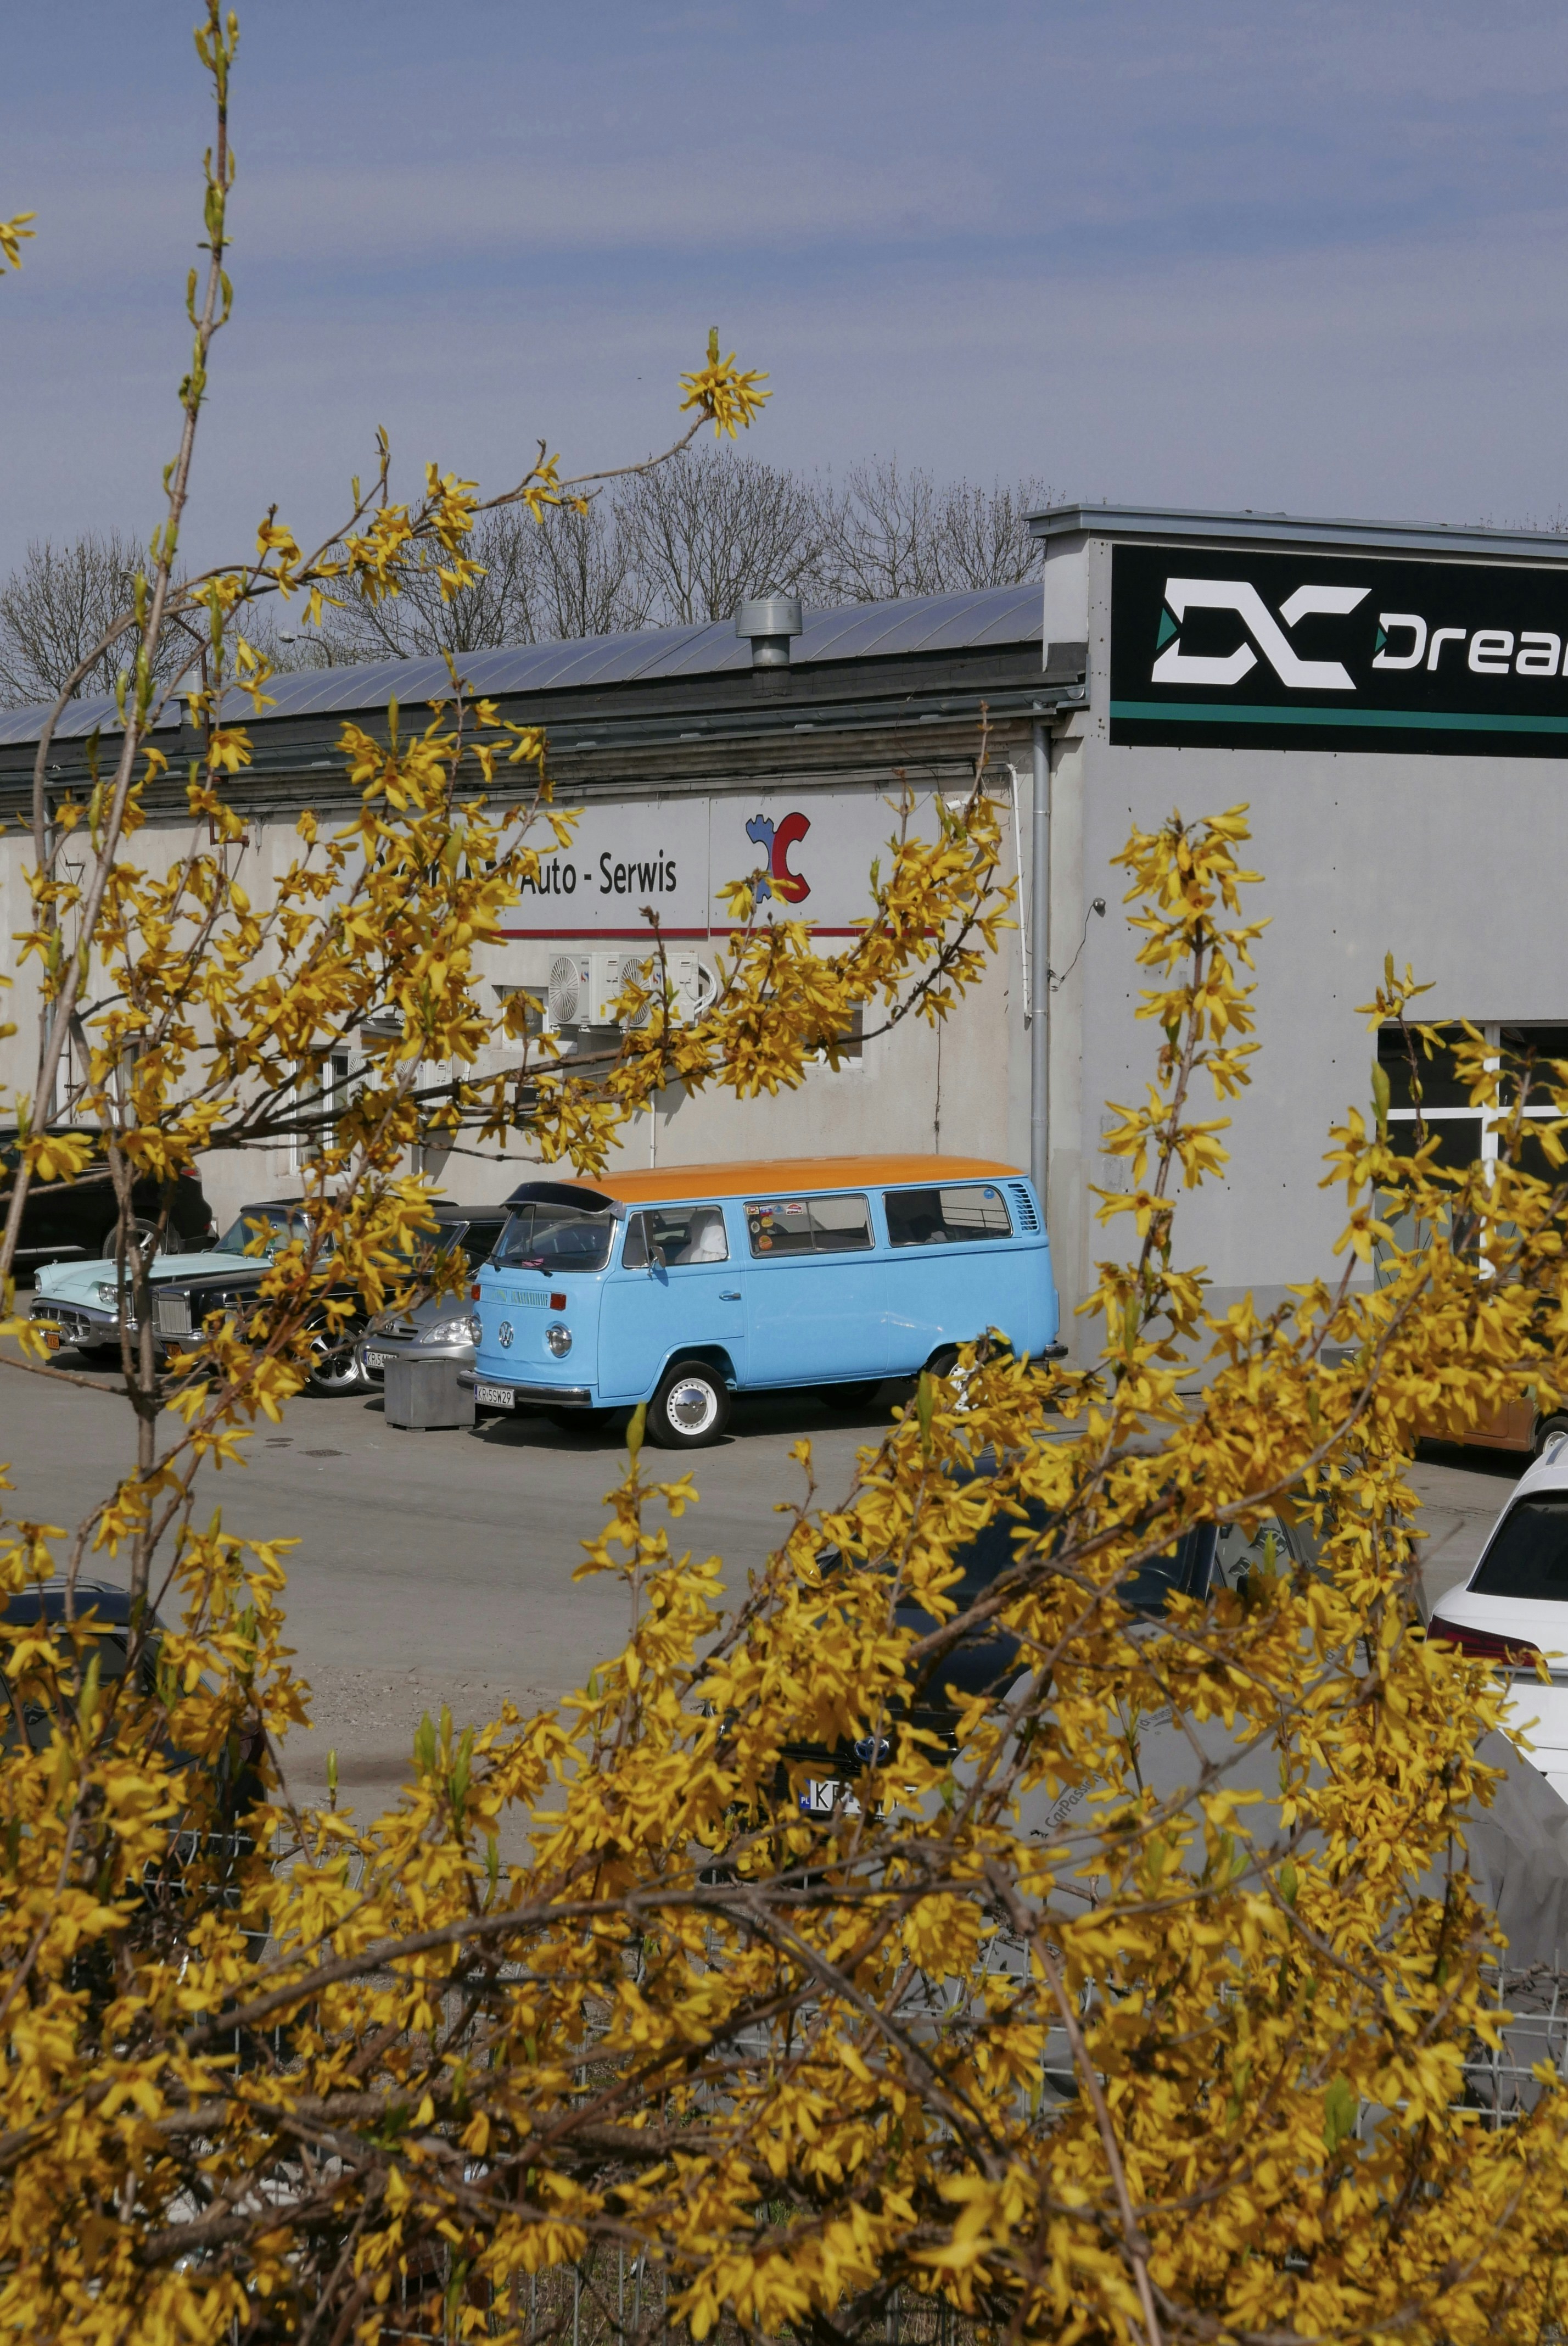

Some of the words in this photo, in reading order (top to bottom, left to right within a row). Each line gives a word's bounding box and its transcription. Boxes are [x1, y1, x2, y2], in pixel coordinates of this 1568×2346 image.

[1373, 613, 1568, 676] Drea
[520, 857, 576, 895] Auto
[600, 849, 677, 894] Serwis
